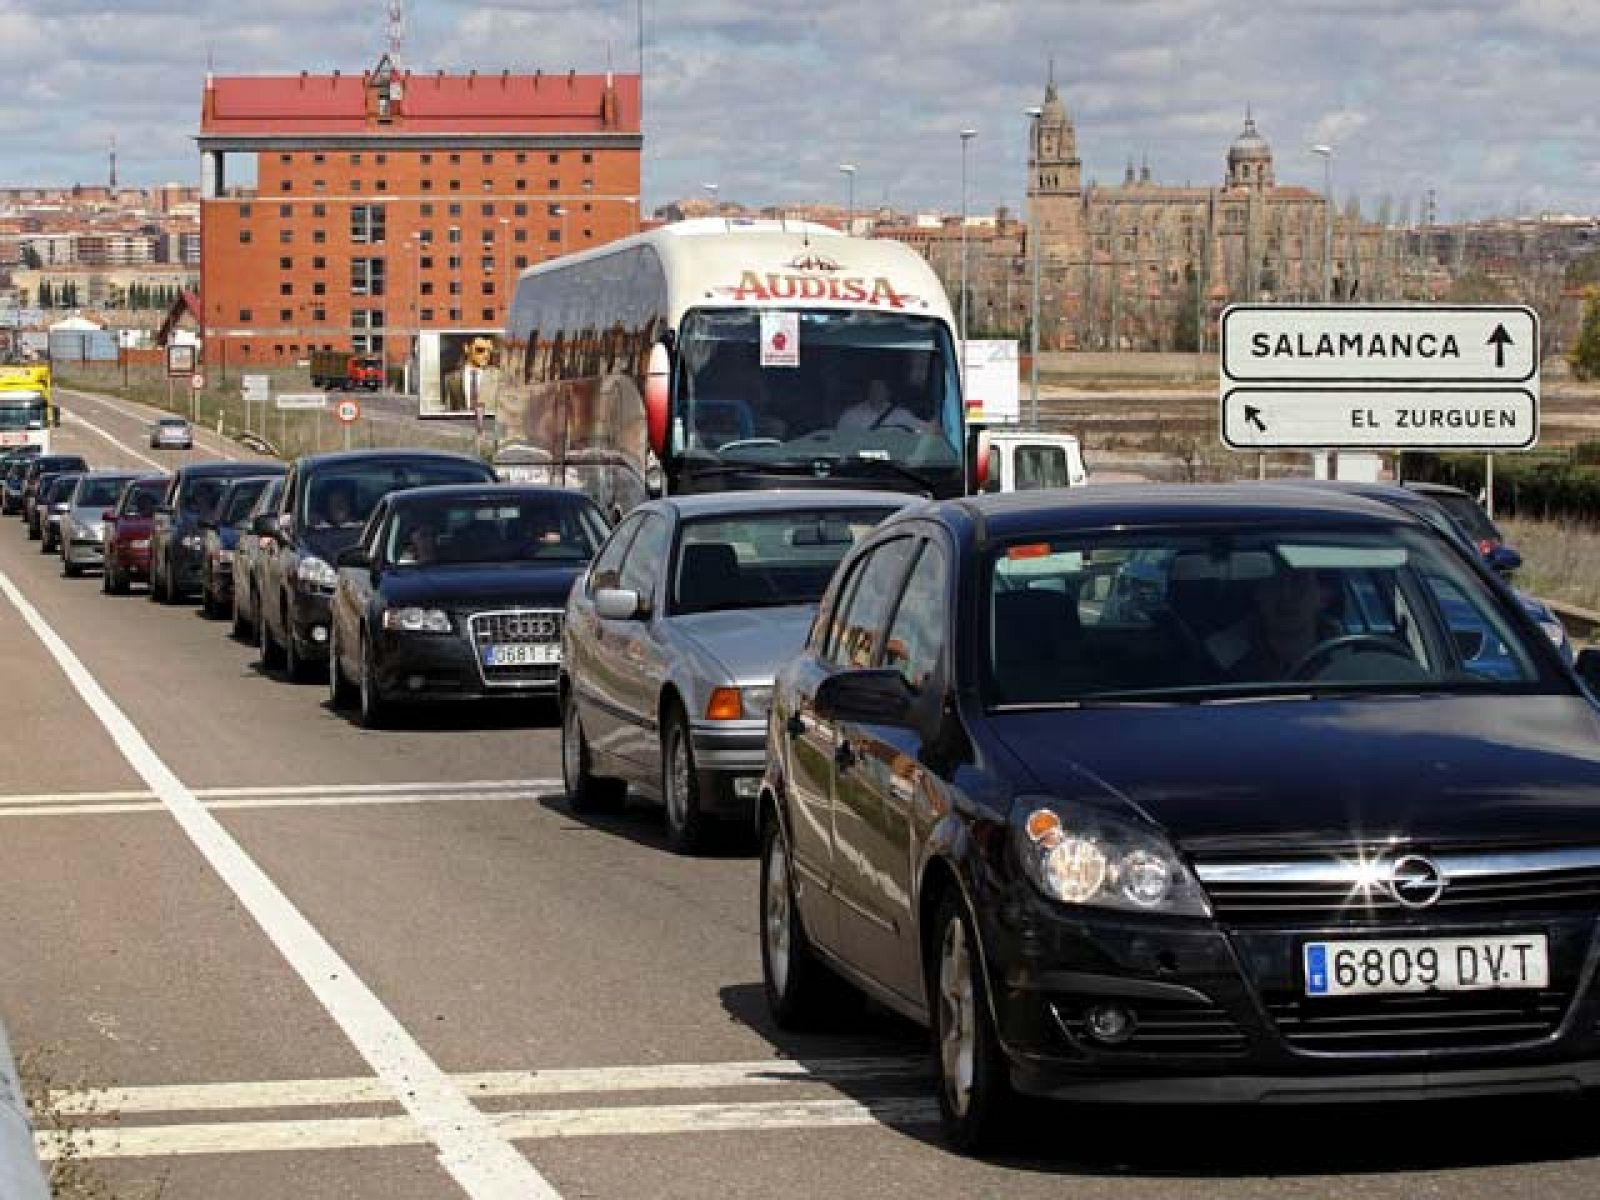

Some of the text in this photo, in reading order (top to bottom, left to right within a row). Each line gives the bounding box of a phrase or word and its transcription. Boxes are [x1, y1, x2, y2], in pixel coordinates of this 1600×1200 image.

[734, 269, 906, 308] AUDISA
[1251, 333, 1460, 358] SALAMANCA
[1351, 409, 1516, 428] EL ZURGUEN
[1334, 946, 1439, 986] 6809
